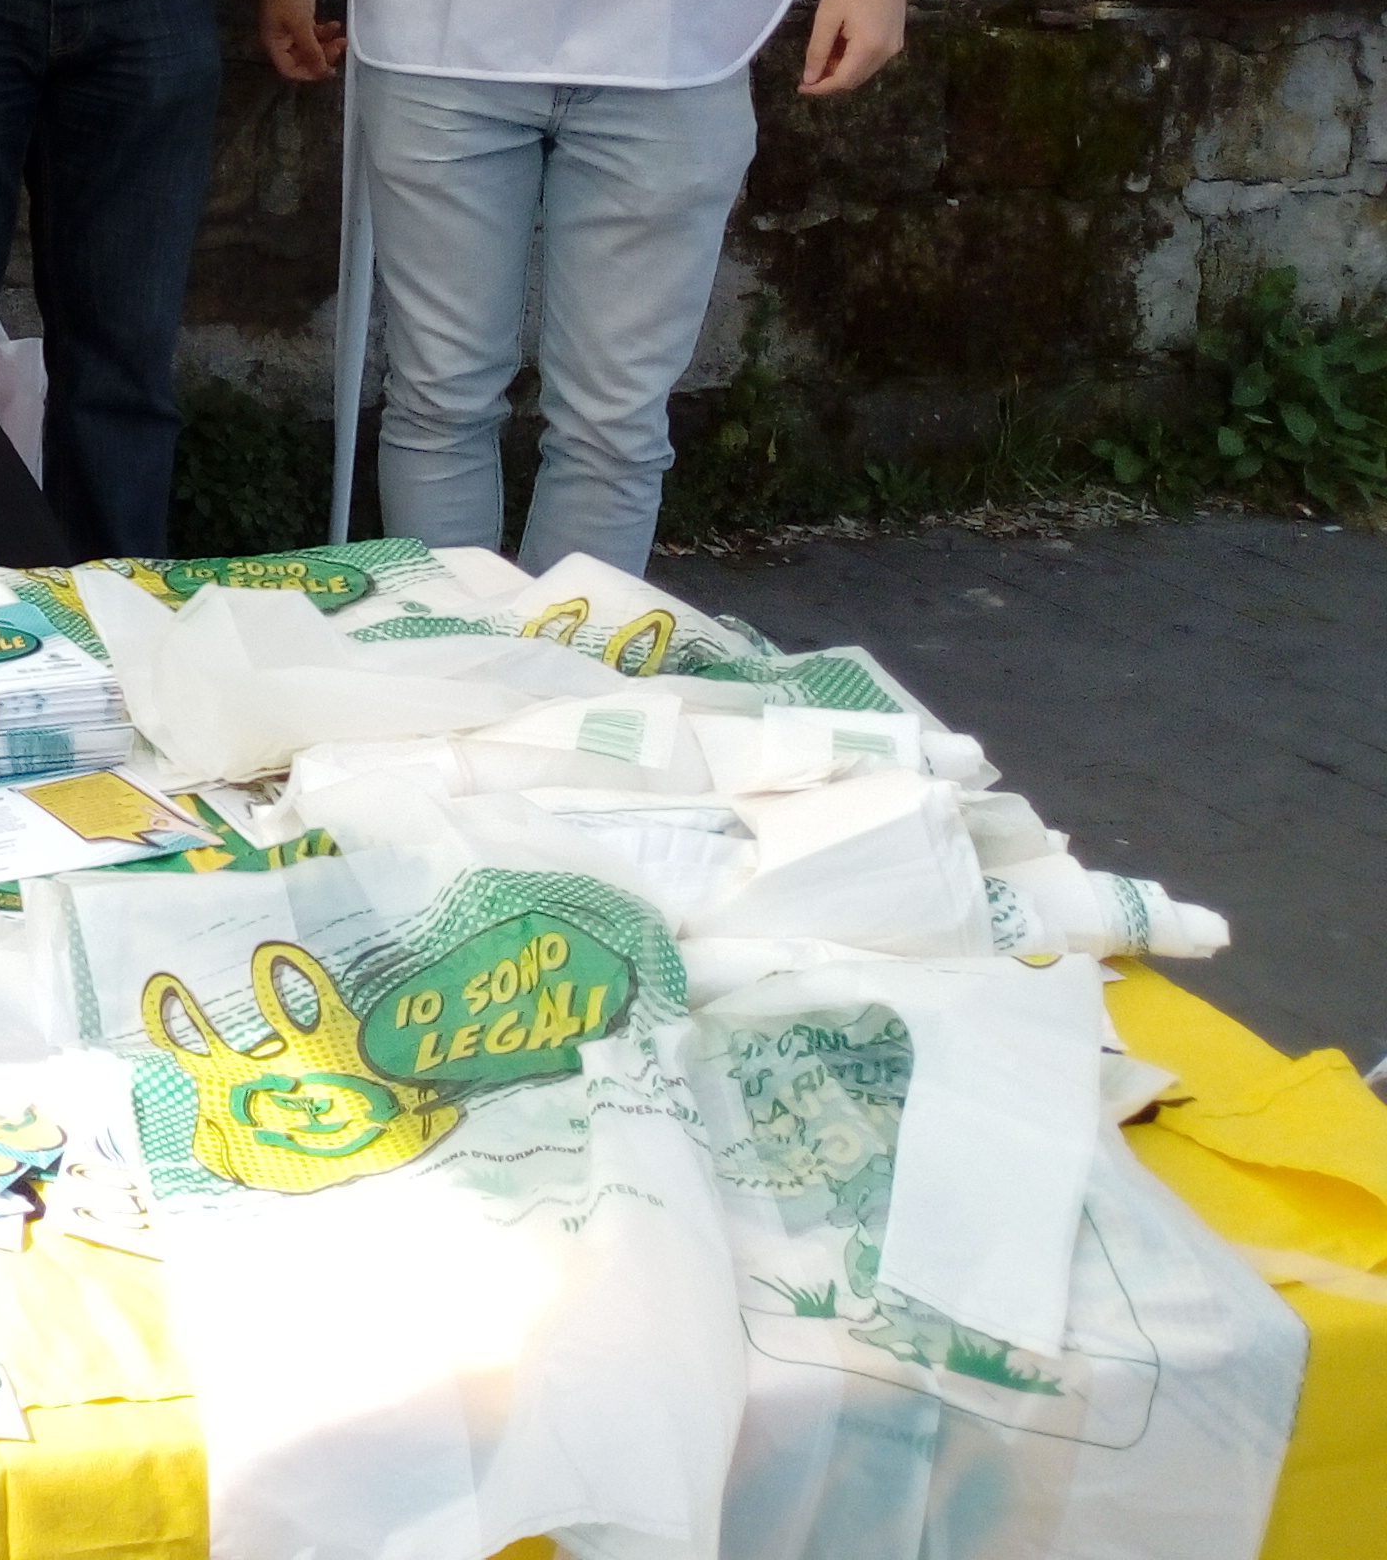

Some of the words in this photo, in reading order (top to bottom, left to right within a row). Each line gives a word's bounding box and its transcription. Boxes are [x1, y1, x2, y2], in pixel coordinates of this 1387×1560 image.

[184, 567, 217, 579] IO
[227, 561, 309, 578] SONO
[217, 575, 350, 593] EGALE
[396, 990, 443, 1029] IO
[462, 932, 569, 1016] SONO
[470, 1144, 586, 1164] D'INFORMAZIONE
